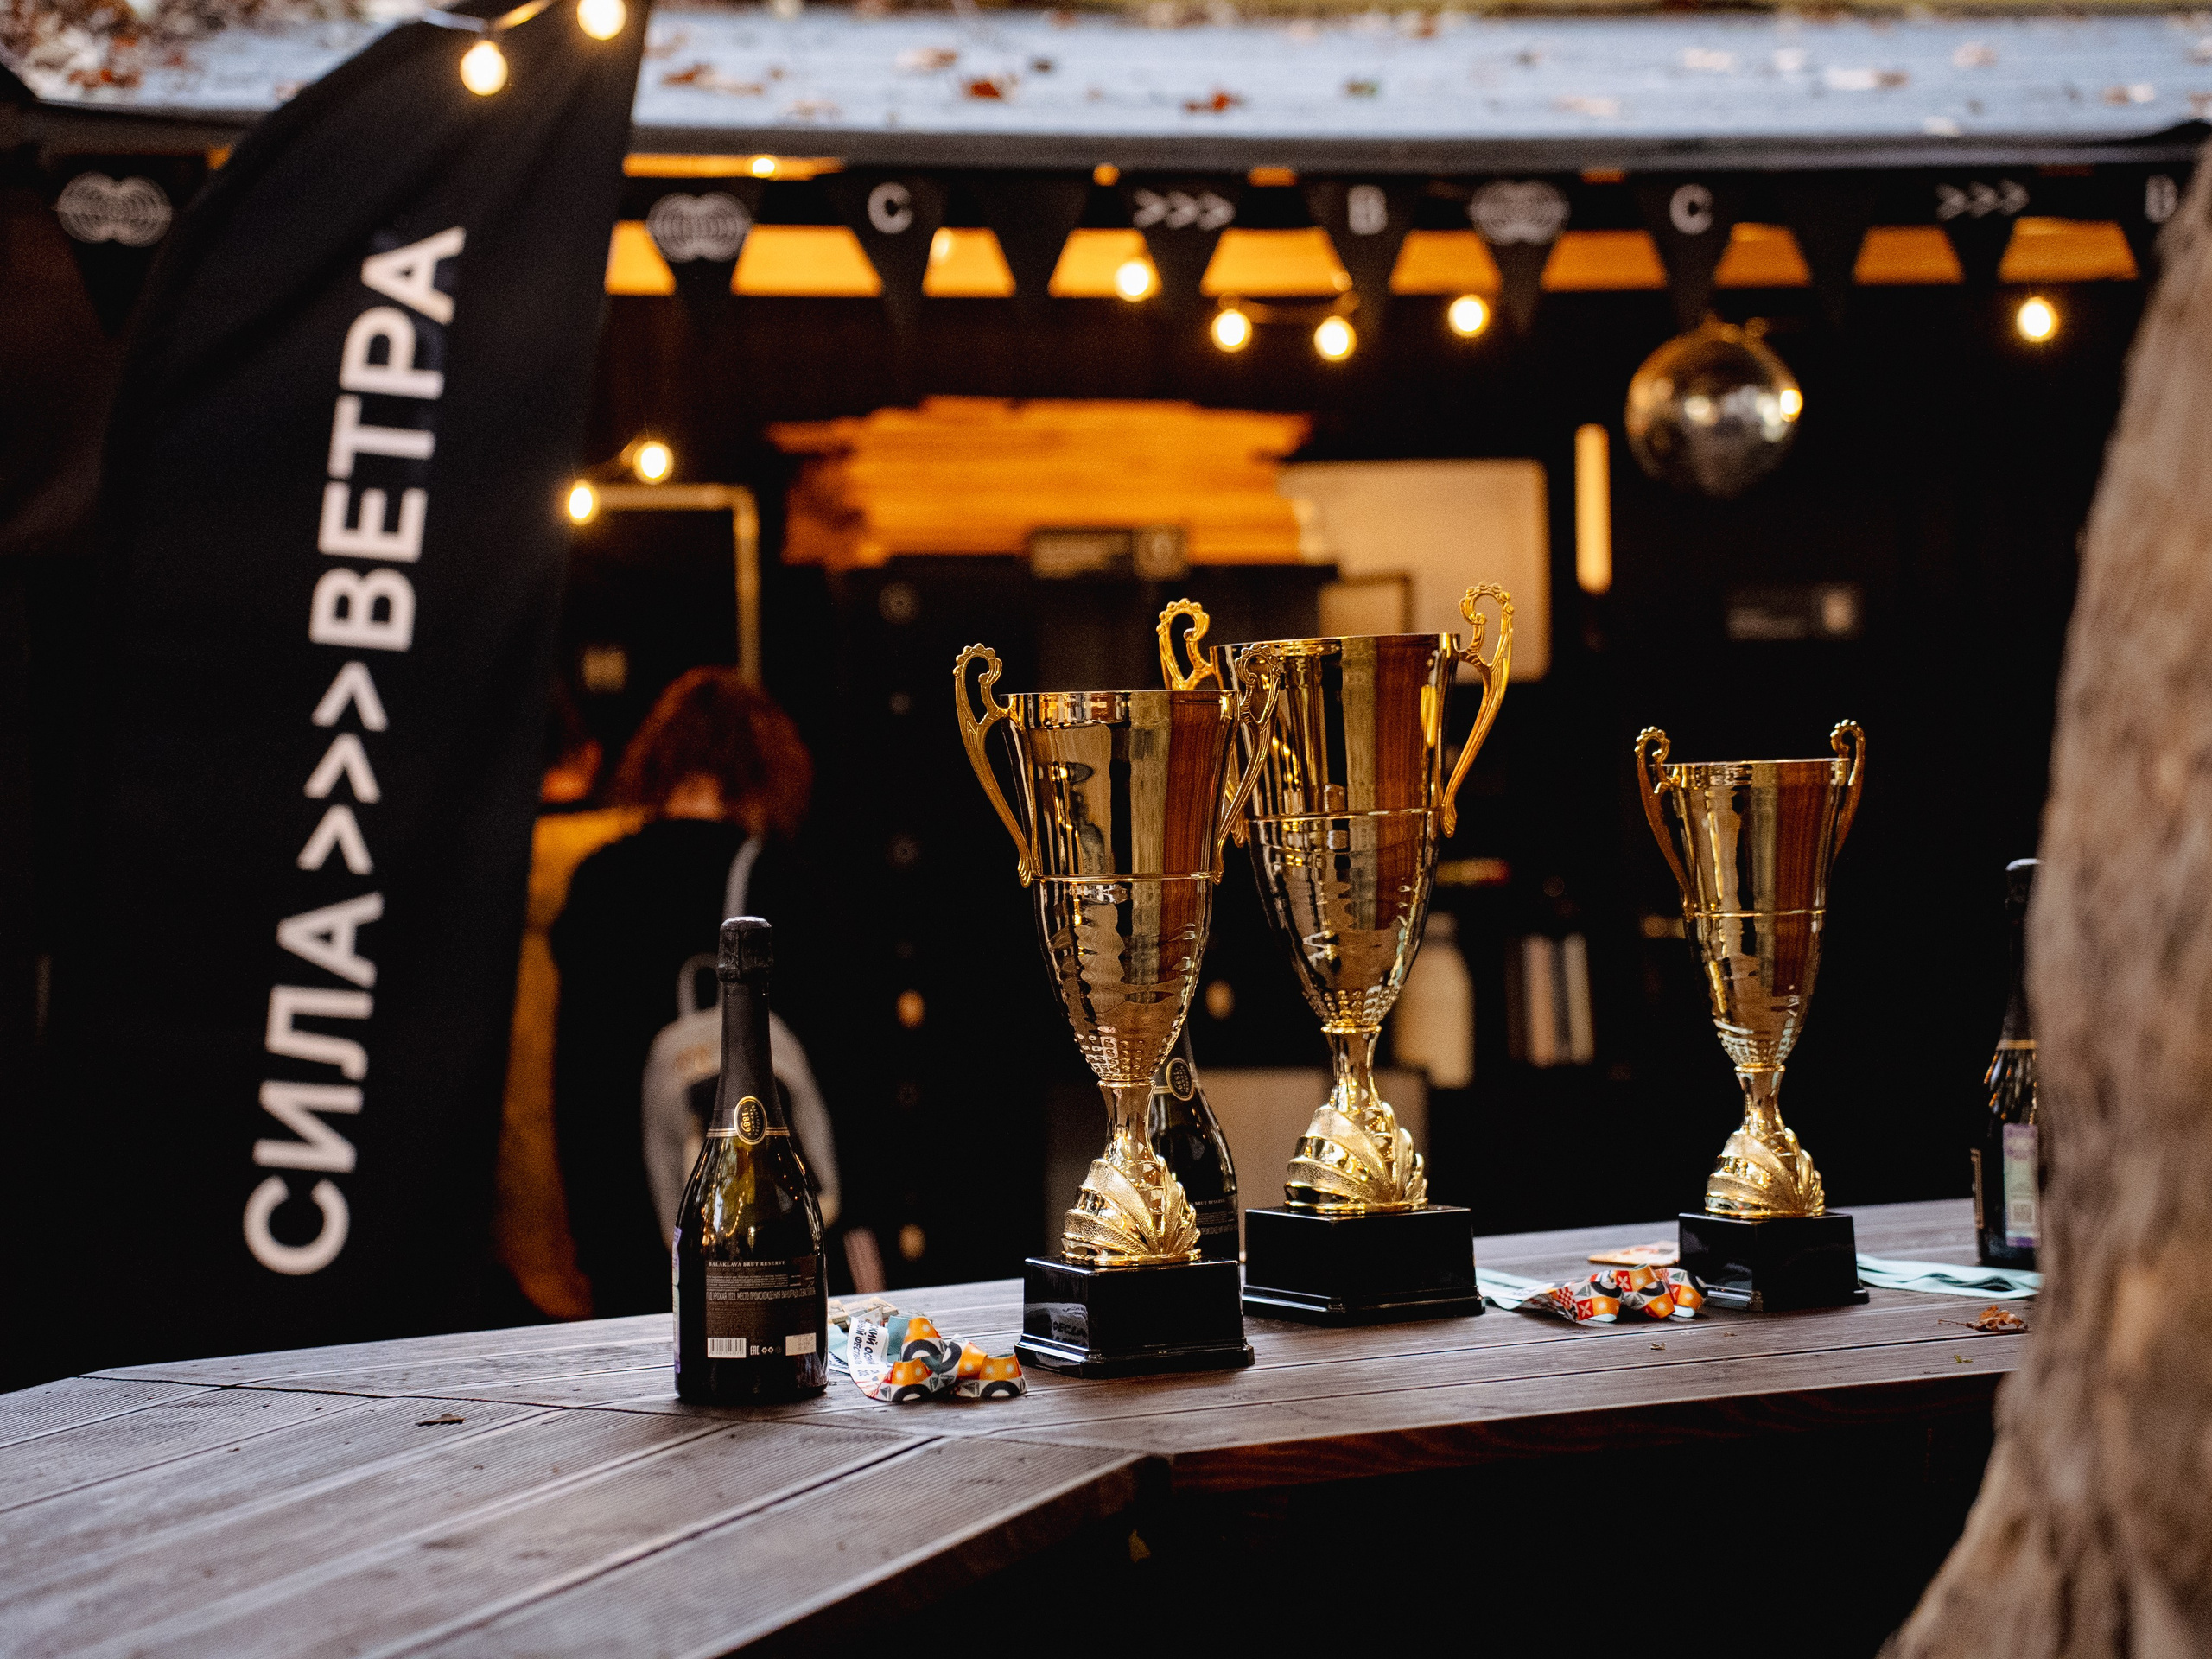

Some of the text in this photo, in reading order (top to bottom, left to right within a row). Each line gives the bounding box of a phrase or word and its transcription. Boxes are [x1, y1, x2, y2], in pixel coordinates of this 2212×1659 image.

[243, 226, 467, 1276] СИЛА ВЕТРА
[741, 1112, 751, 1132] 1889
